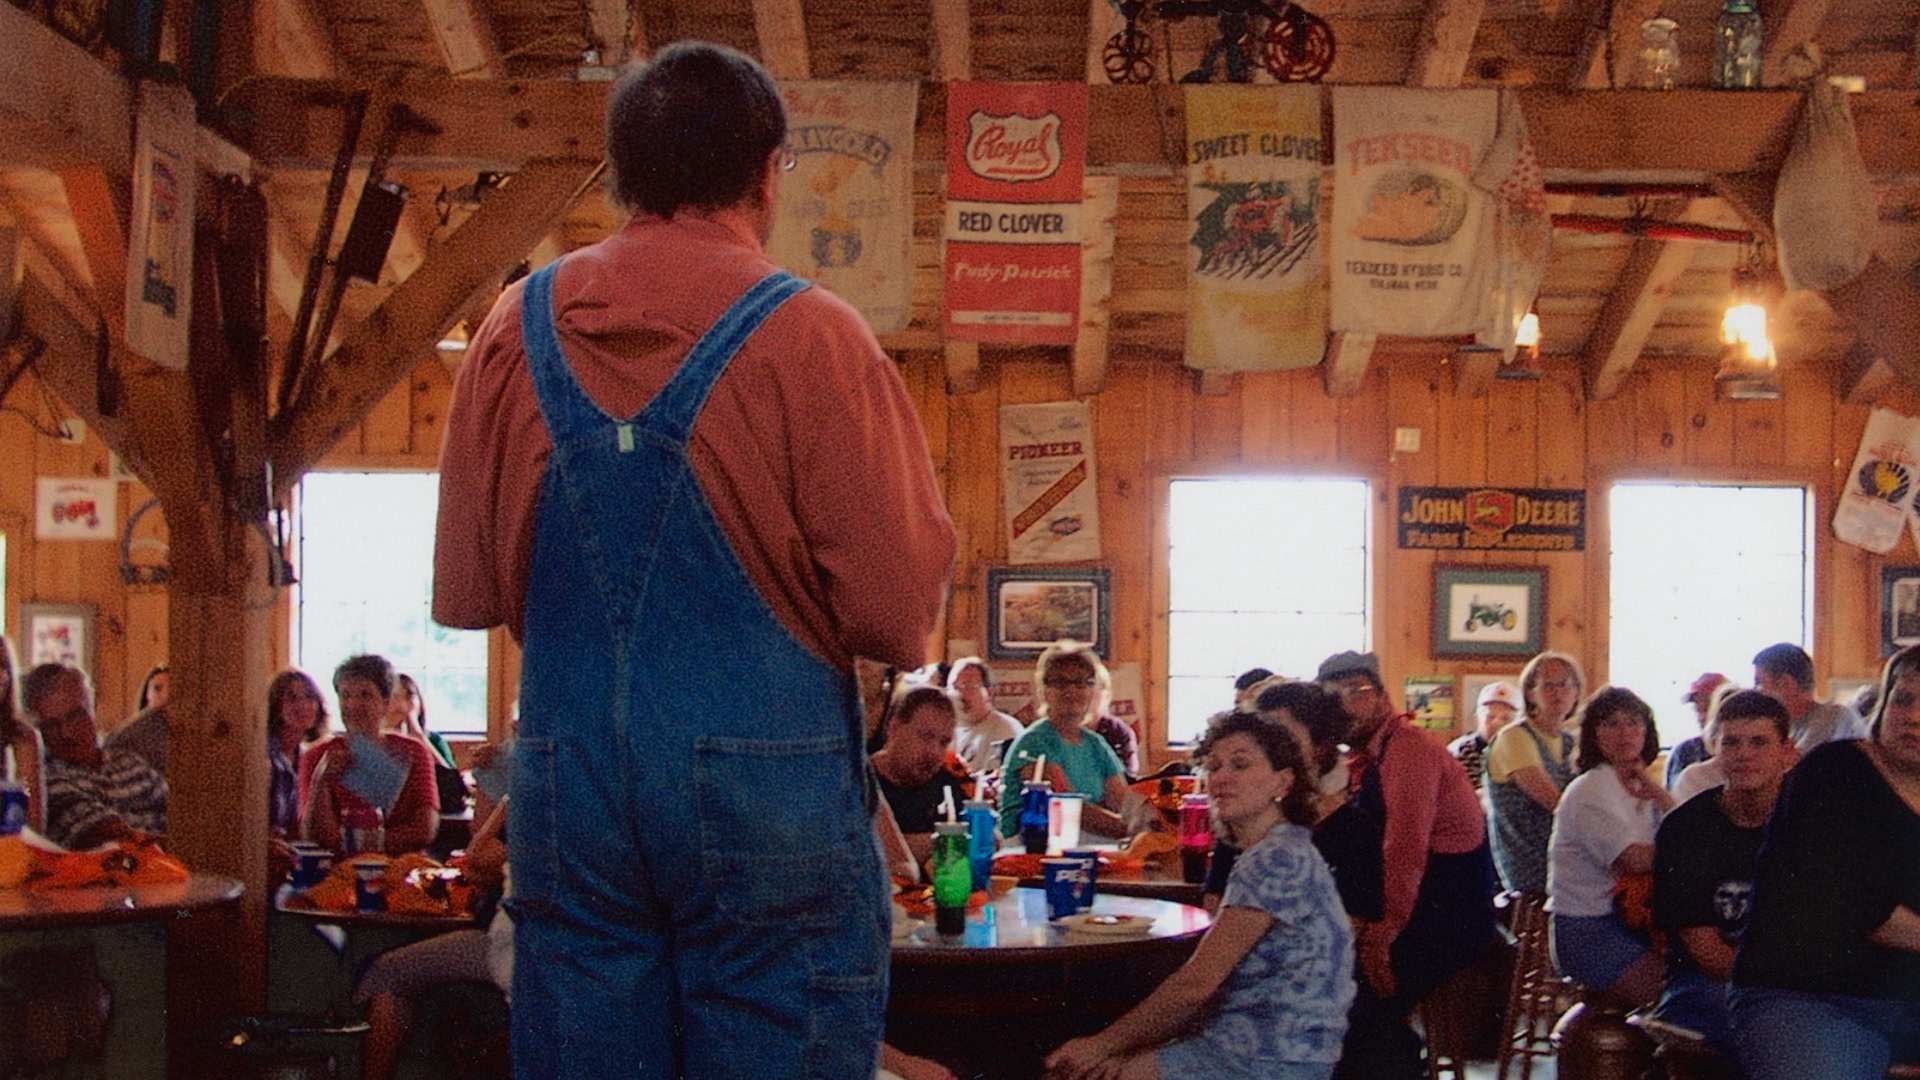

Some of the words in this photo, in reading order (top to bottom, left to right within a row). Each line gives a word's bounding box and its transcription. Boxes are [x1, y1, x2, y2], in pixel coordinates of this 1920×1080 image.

[973, 122, 1053, 174] Royal
[1192, 132, 1250, 164] SWEET
[1260, 132, 1322, 161] CLOVER
[959, 209, 991, 232] RED
[999, 213, 1063, 233] CLOVER
[1009, 441, 1083, 460] PIONEER
[1402, 495, 1464, 524] JOHN
[1516, 496, 1580, 526] DEERE
